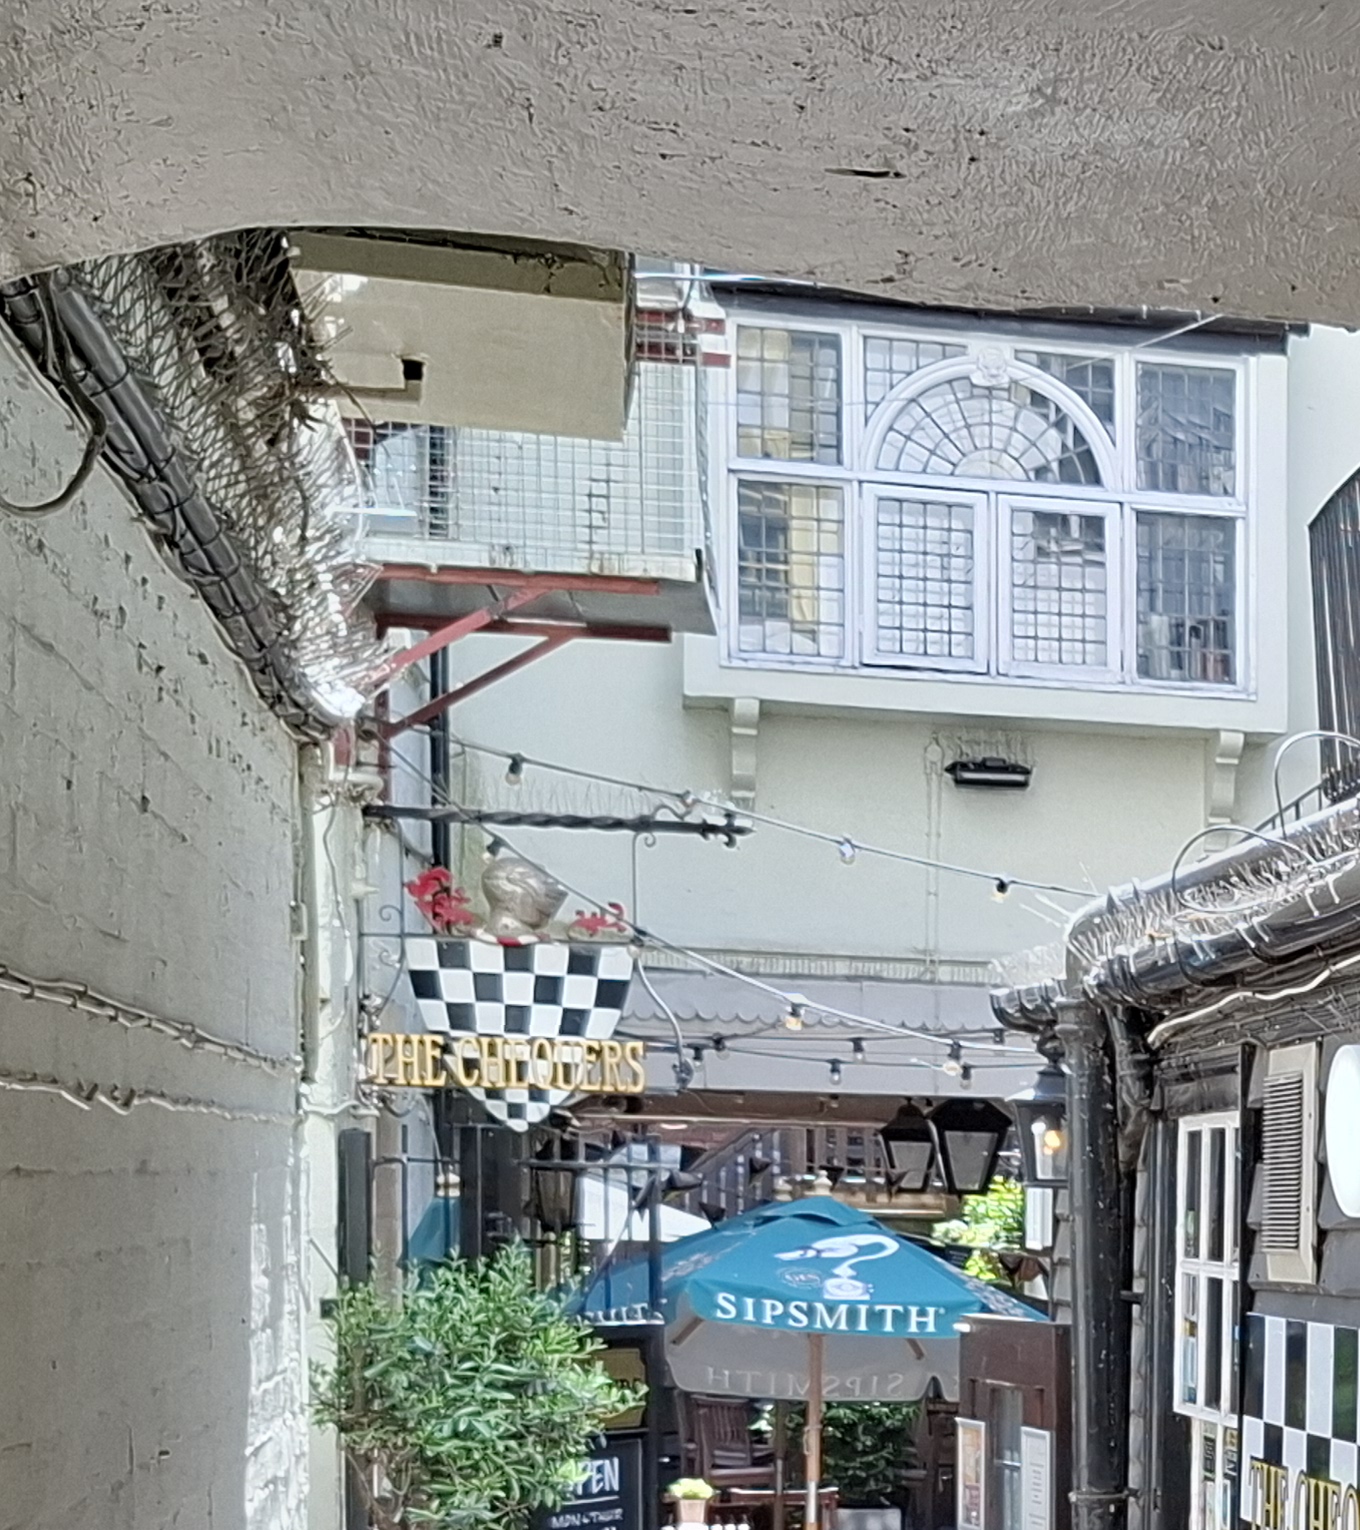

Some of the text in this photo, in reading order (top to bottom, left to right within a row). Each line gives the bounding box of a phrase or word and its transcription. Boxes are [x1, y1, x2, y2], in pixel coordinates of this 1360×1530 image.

[367, 1033, 646, 1093] THE CHEQUERS
[715, 1292, 938, 1333] SIPSMITH
[565, 1456, 620, 1496] PEN
